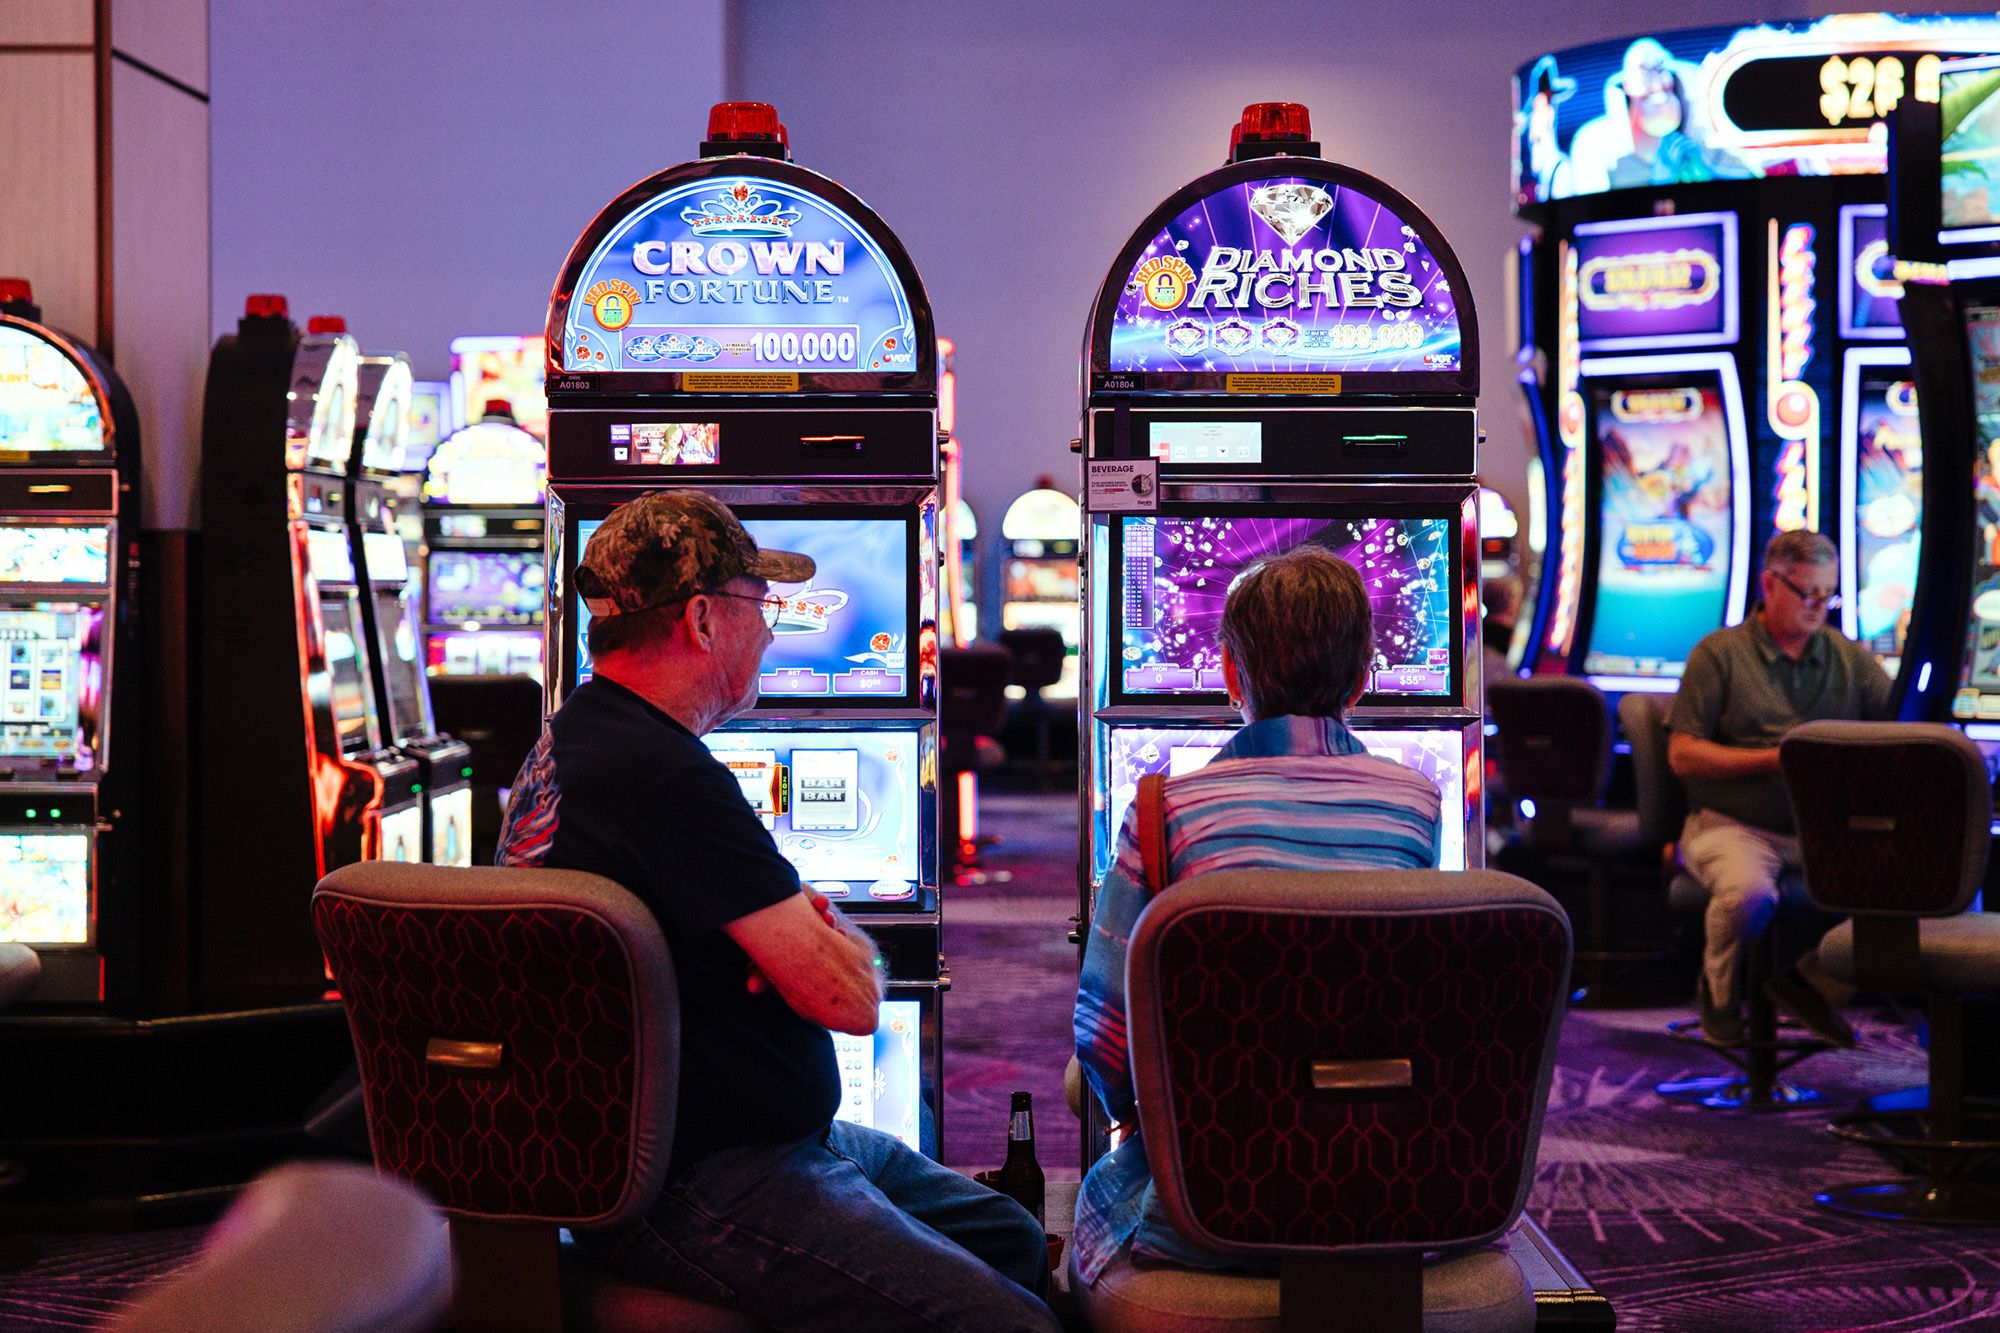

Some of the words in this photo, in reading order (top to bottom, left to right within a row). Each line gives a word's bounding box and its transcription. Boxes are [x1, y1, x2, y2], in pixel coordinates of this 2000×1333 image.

[633, 240, 845, 276] CROWN
[1135, 257, 1161, 283] RED
[1162, 255, 1197, 283] SPIN
[1201, 245, 1406, 273] DIAMOND
[584, 281, 609, 305] RED
[610, 279, 642, 305] SPIN
[645, 279, 836, 304] FORTUNE
[1187, 271, 1423, 309] RICHES
[749, 331, 855, 365] 100,000
[1329, 323, 1424, 352] 100,000
[560, 381, 590, 389] A01803
[1104, 380, 1134, 388] A01804
[1091, 465, 1134, 473] BEVERAGE
[791, 679, 798, 689] 0
[1156, 674, 1162, 683] 0
[805, 778, 842, 788] BAR
[805, 790, 842, 801] BAR
